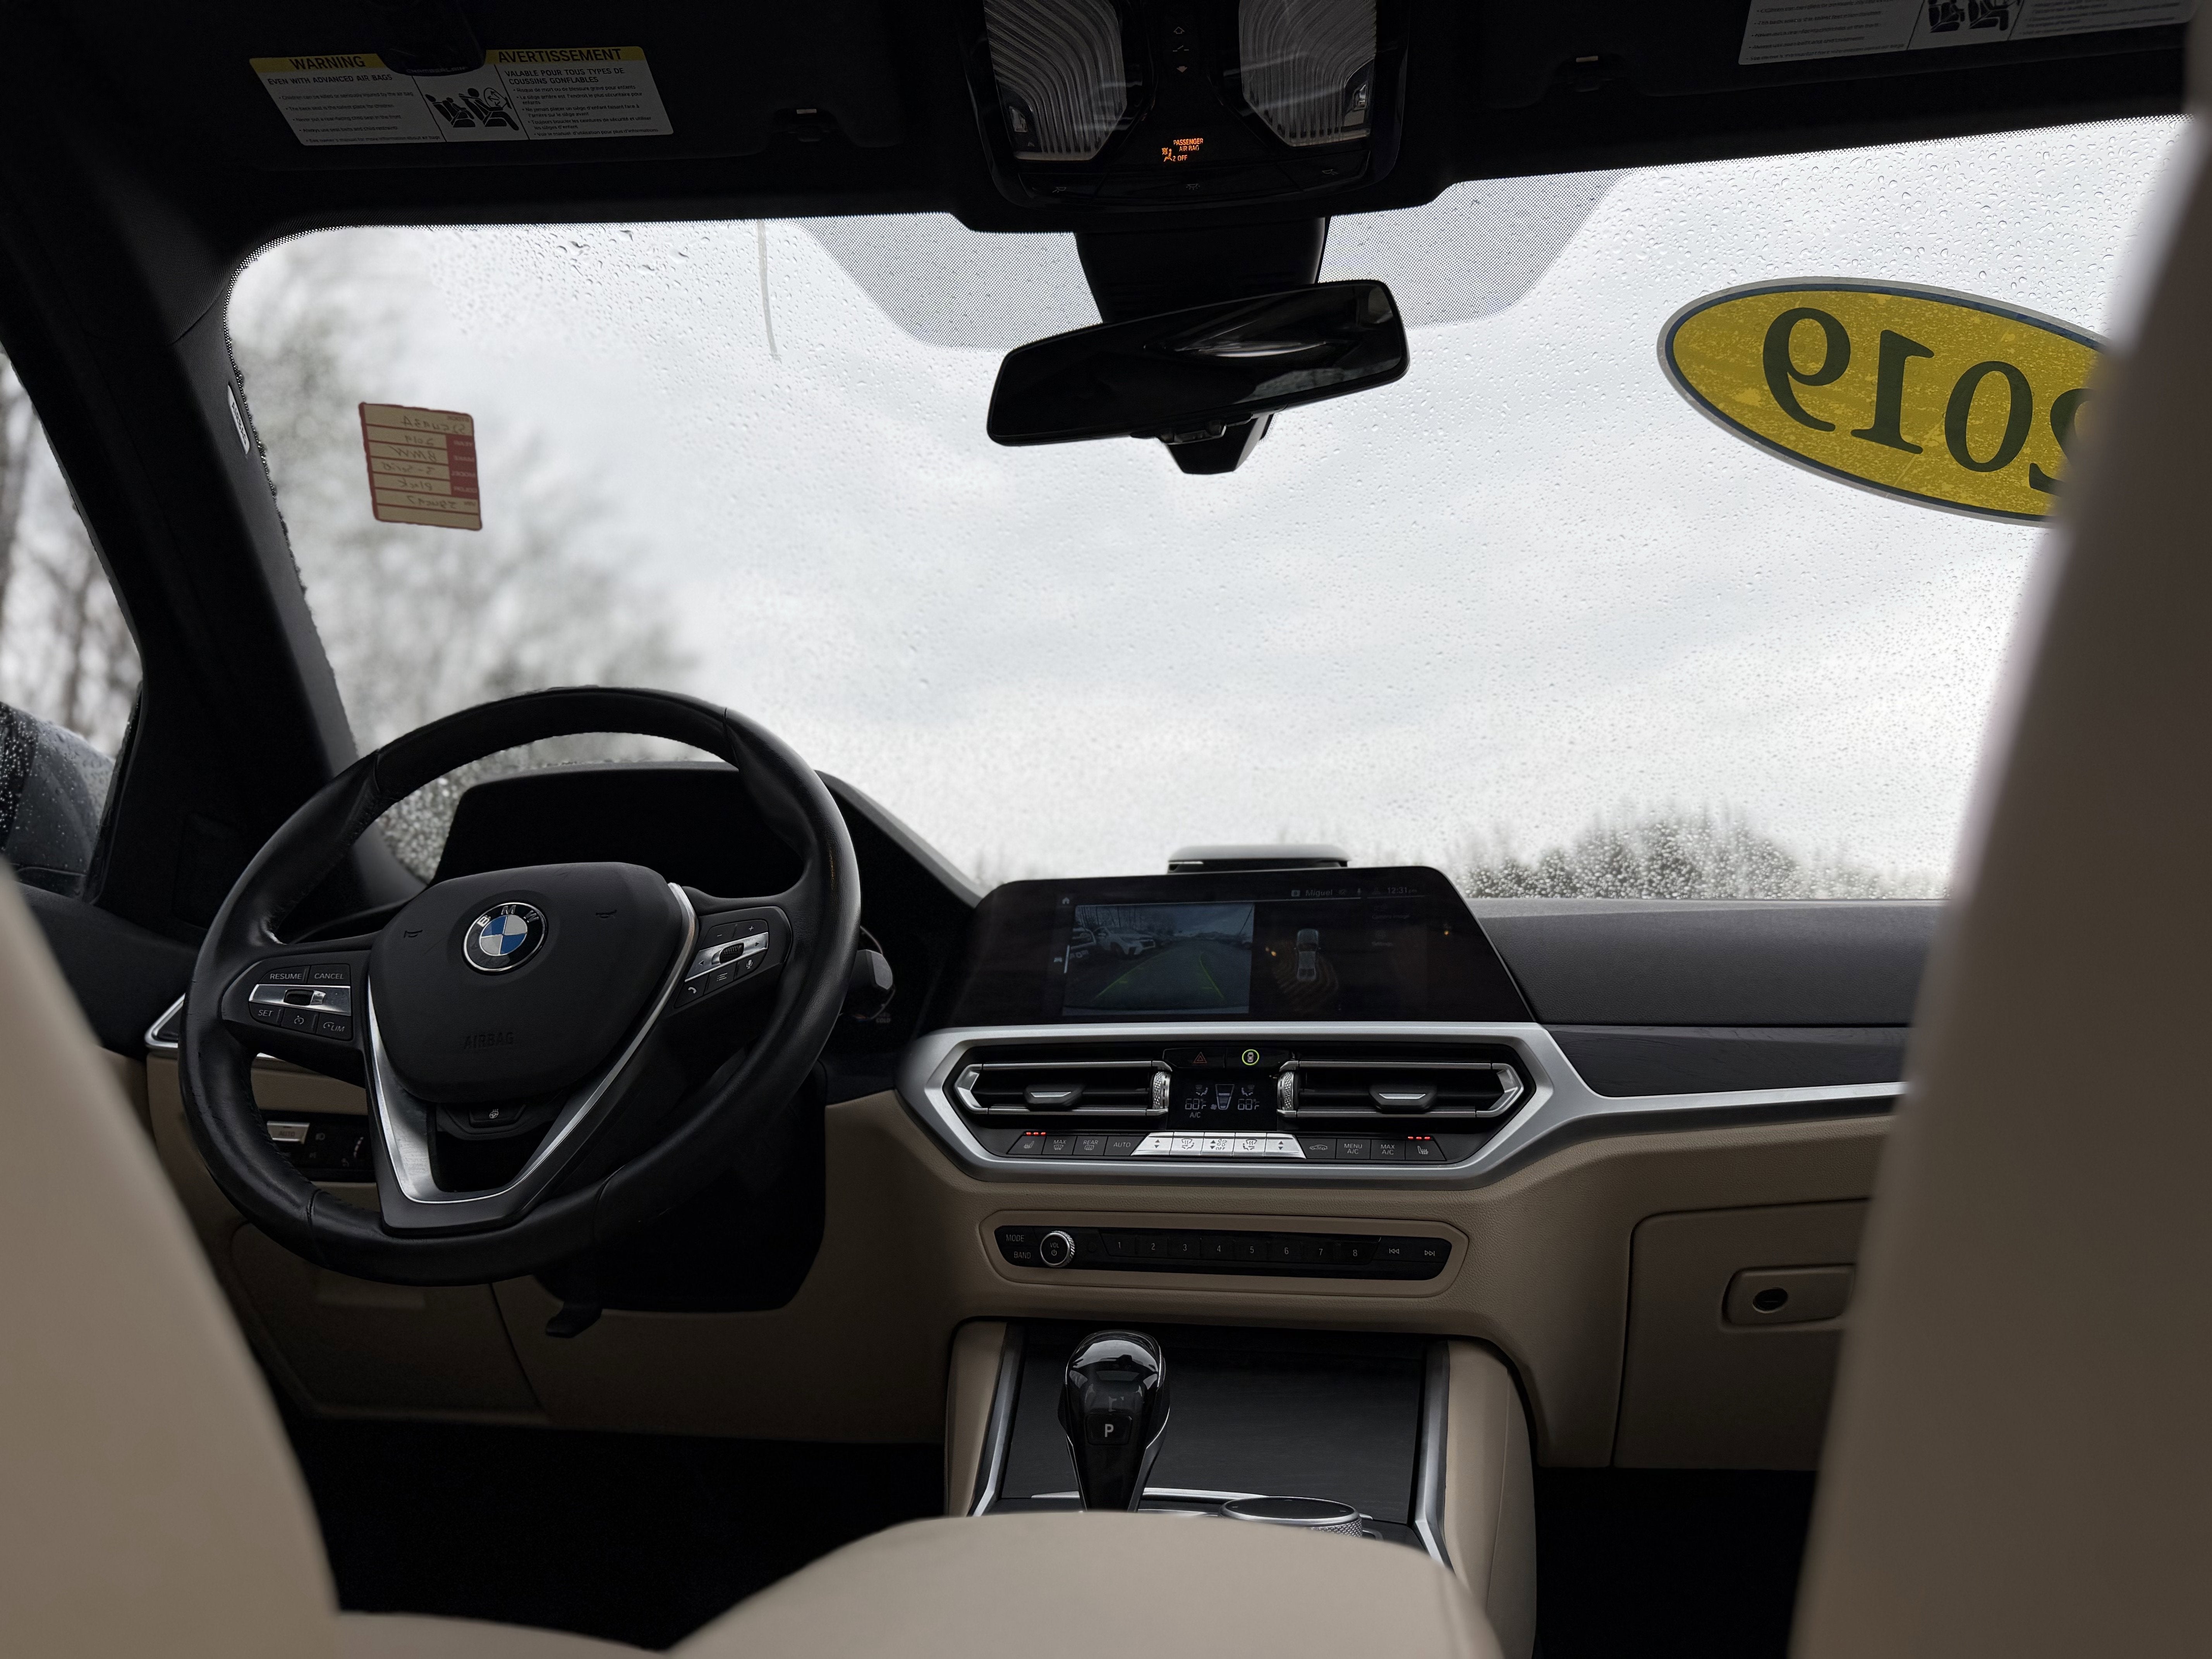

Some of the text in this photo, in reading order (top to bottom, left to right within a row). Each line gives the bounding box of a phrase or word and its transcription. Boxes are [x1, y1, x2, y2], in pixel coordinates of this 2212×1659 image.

[289, 56, 366, 70] WARNING
[499, 49, 621, 62] AVERTISSEMENT
[232, 402, 247, 445] AIRBAG
[477, 905, 539, 927] BMW
[464, 1032, 514, 1049] AIRBAG
[1104, 1424, 1114, 1437] P
